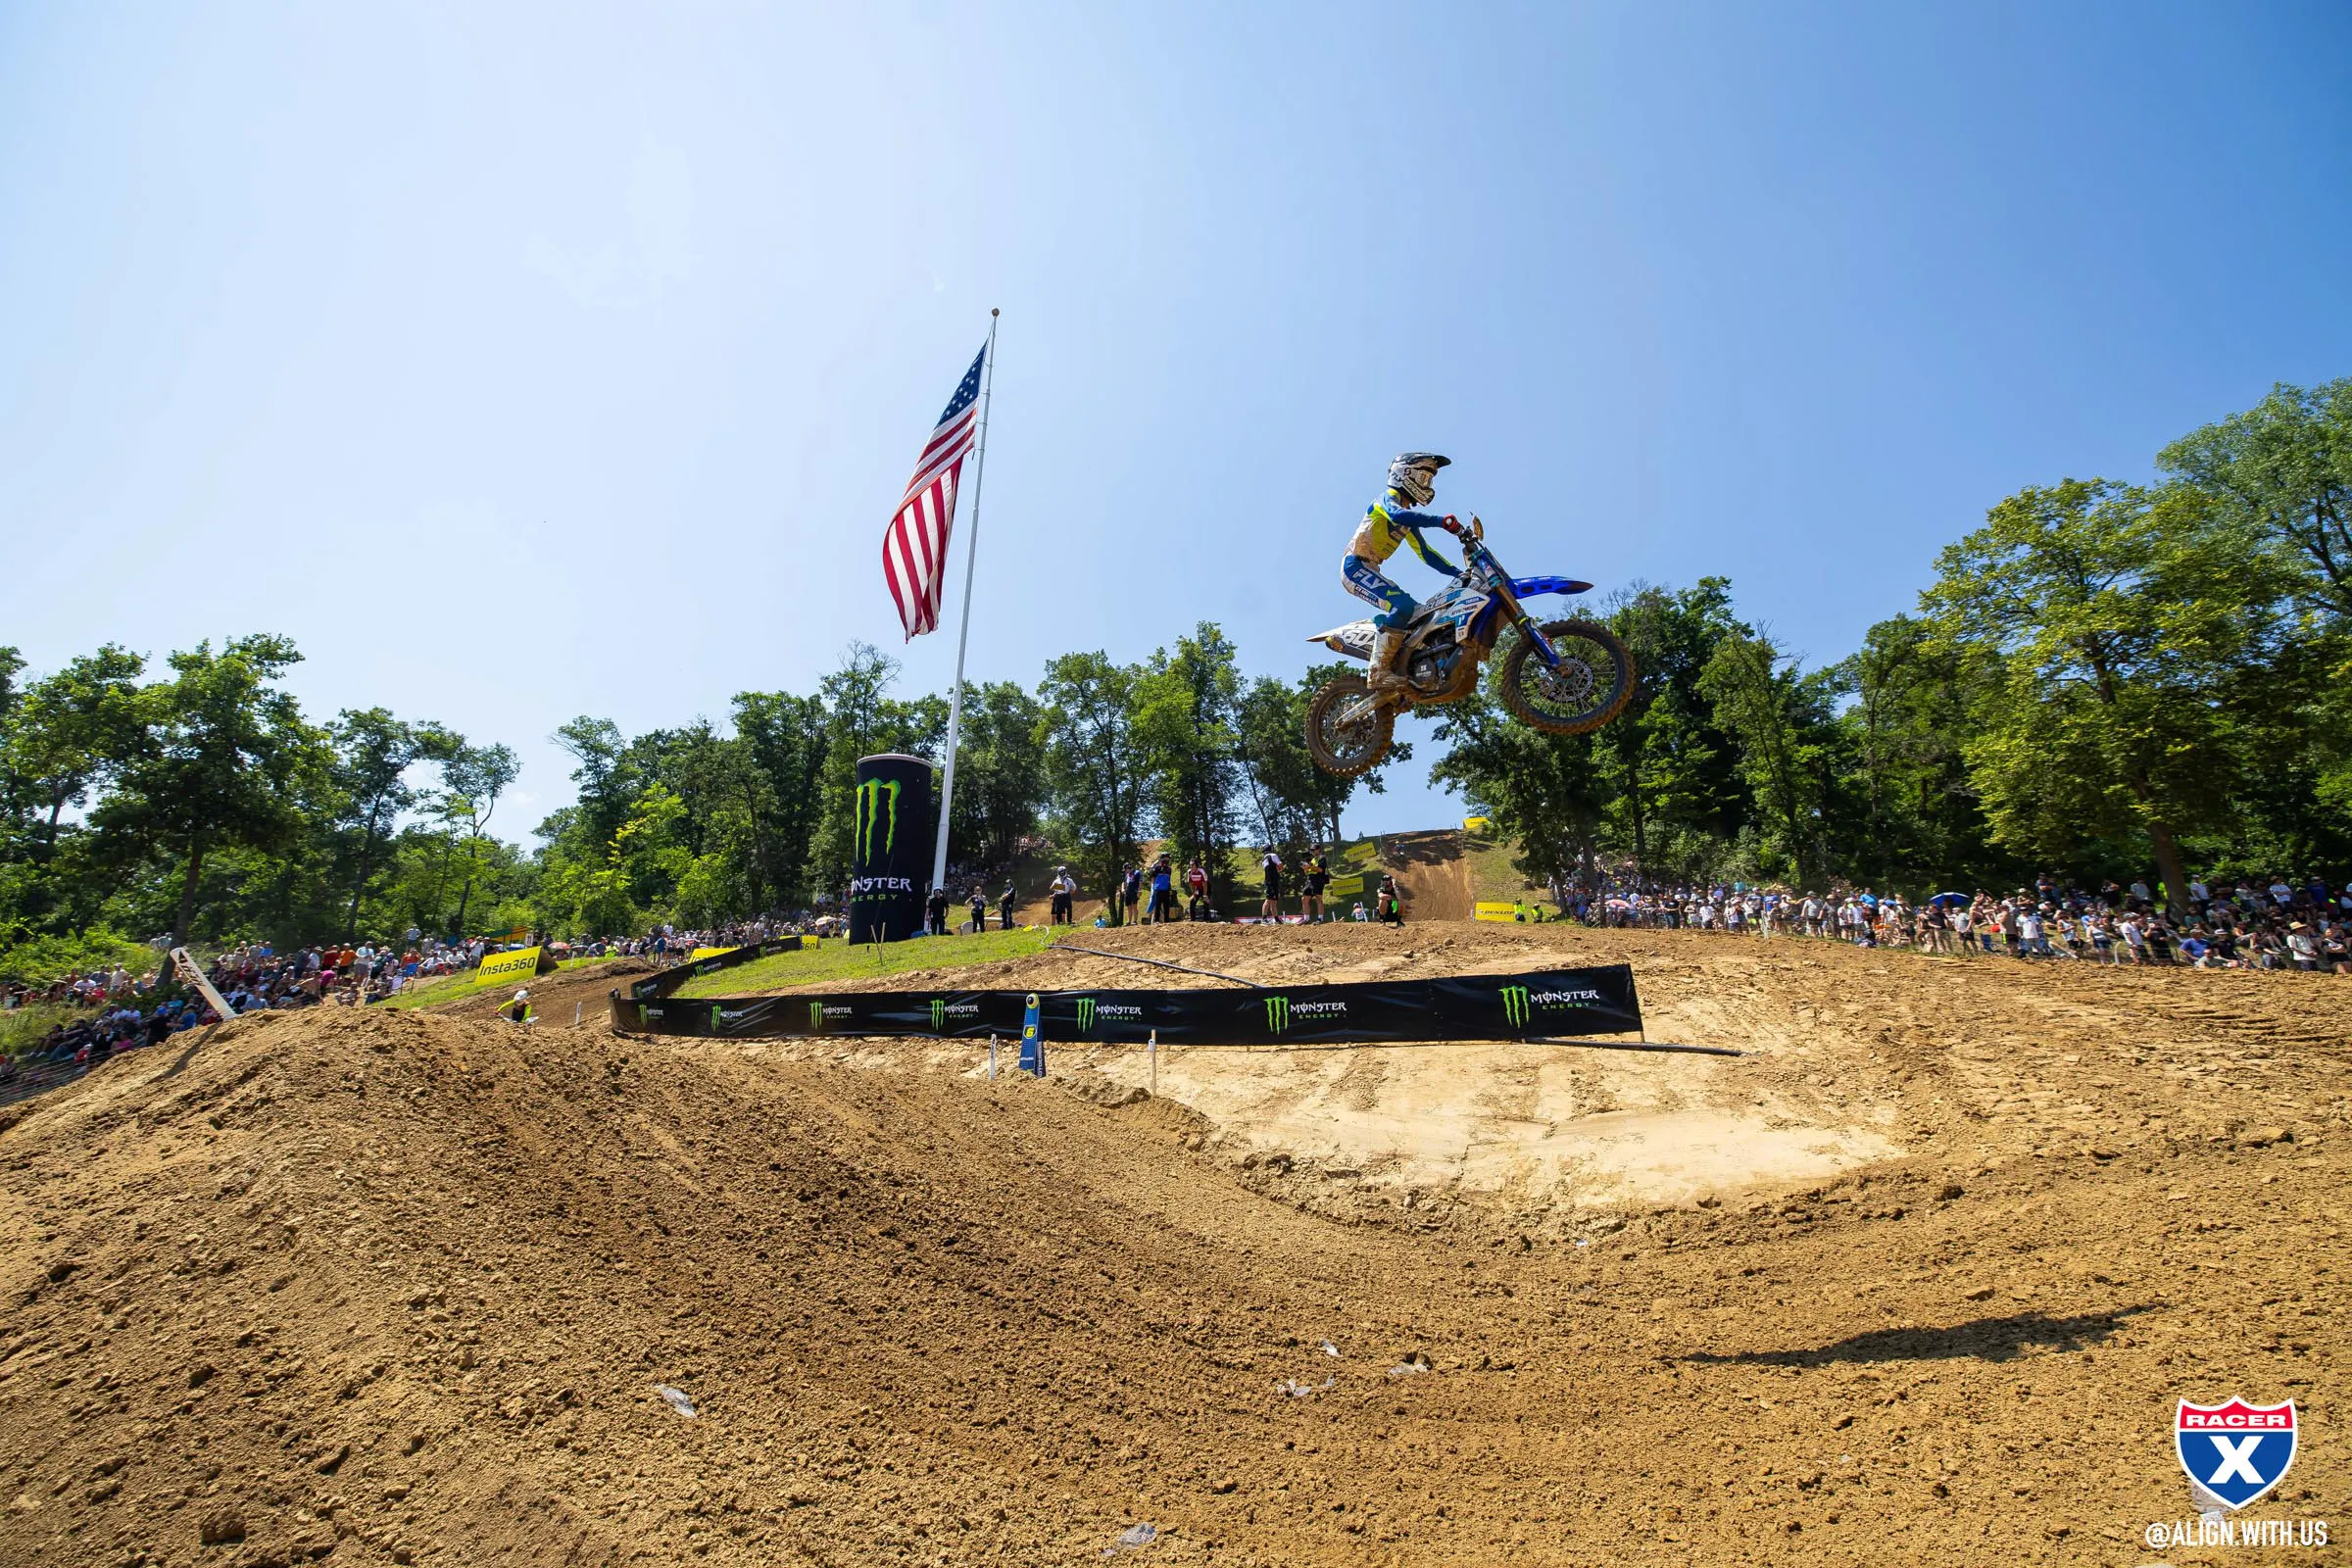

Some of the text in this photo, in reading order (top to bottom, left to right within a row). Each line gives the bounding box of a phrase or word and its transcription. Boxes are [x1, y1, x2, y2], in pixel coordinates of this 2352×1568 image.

[1352, 568, 1388, 589] FLY
[479, 956, 536, 976] Insta360
[1530, 989, 1599, 1004] MONSTER
[944, 1004, 979, 1013] MONSTER
[1096, 1004, 1142, 1015] MONSTER
[1290, 1002, 1348, 1013] MONSTER
[1542, 1002, 1591, 1010] ENERGY
